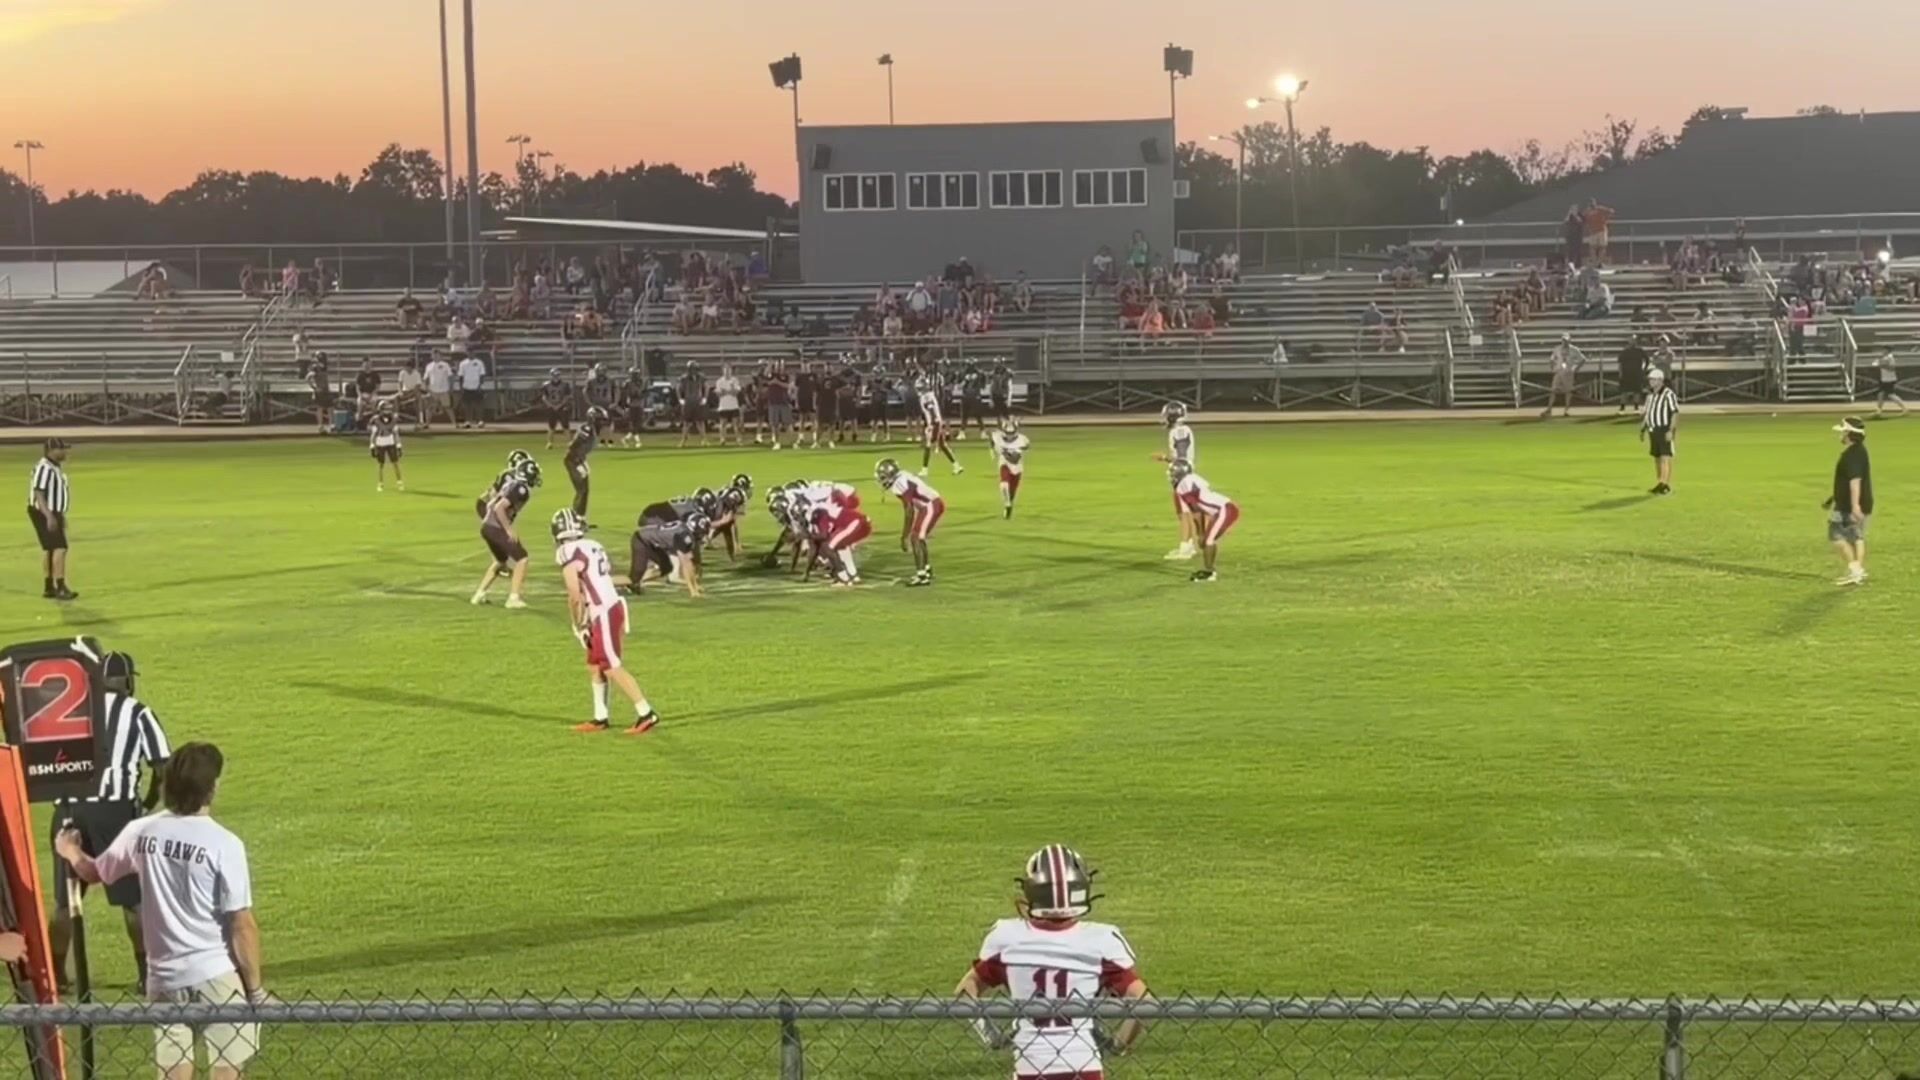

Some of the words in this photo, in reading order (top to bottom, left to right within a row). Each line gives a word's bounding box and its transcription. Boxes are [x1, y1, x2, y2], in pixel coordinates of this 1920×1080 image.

[21, 658, 93, 741] 2
[28, 763, 53, 776] BSN
[54, 759, 94, 773] SPORTS
[163, 839, 206, 865] DAWG
[1032, 967, 1072, 1028] 11
